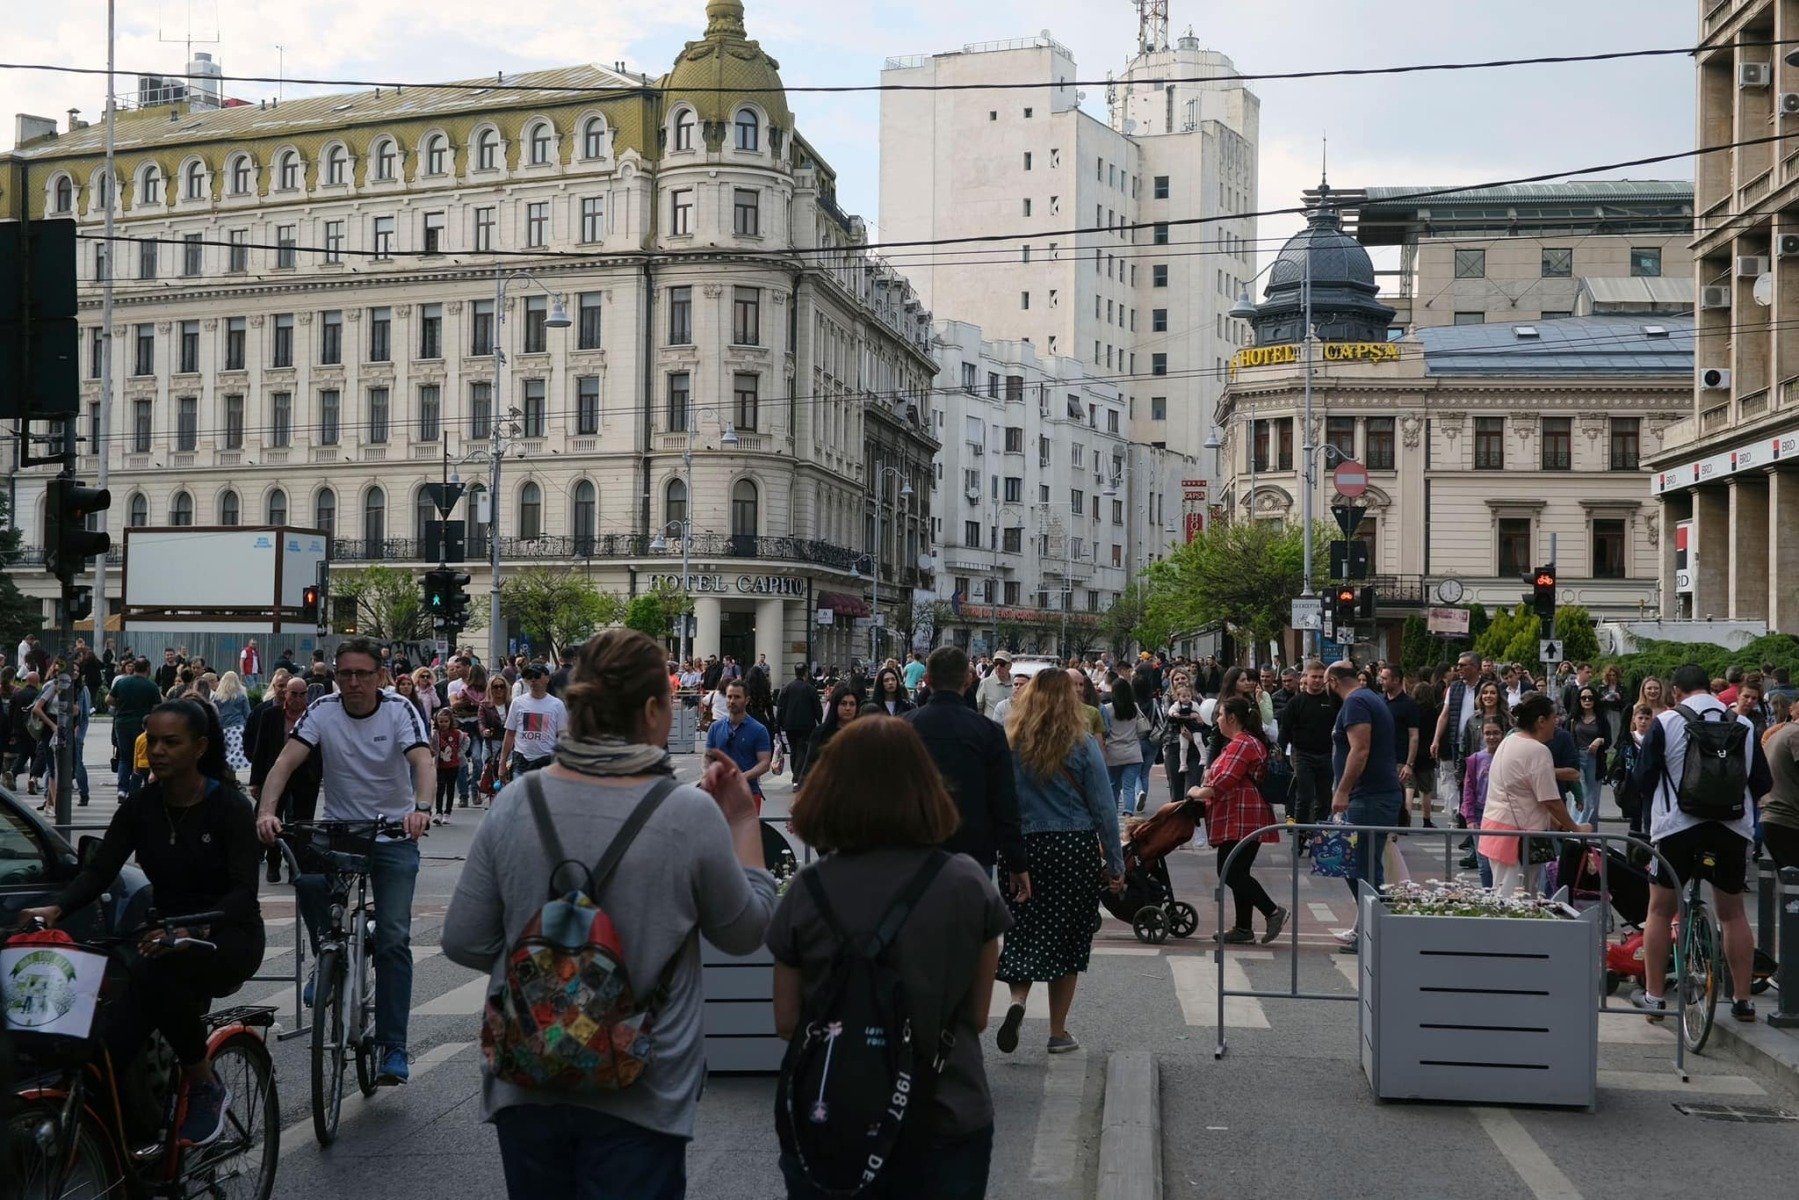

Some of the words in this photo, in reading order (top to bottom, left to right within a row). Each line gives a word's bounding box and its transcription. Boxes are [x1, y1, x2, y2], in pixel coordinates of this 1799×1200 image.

[1240, 345, 1296, 367] HOTEL
[1782, 439, 1796, 452] BRD
[1740, 452, 1752, 464] BRD
[1702, 463, 1713, 475] BRD
[1667, 474, 1677, 485] BRD
[648, 574, 728, 593] HOTEL
[888, 1072, 911, 1121] 1987
